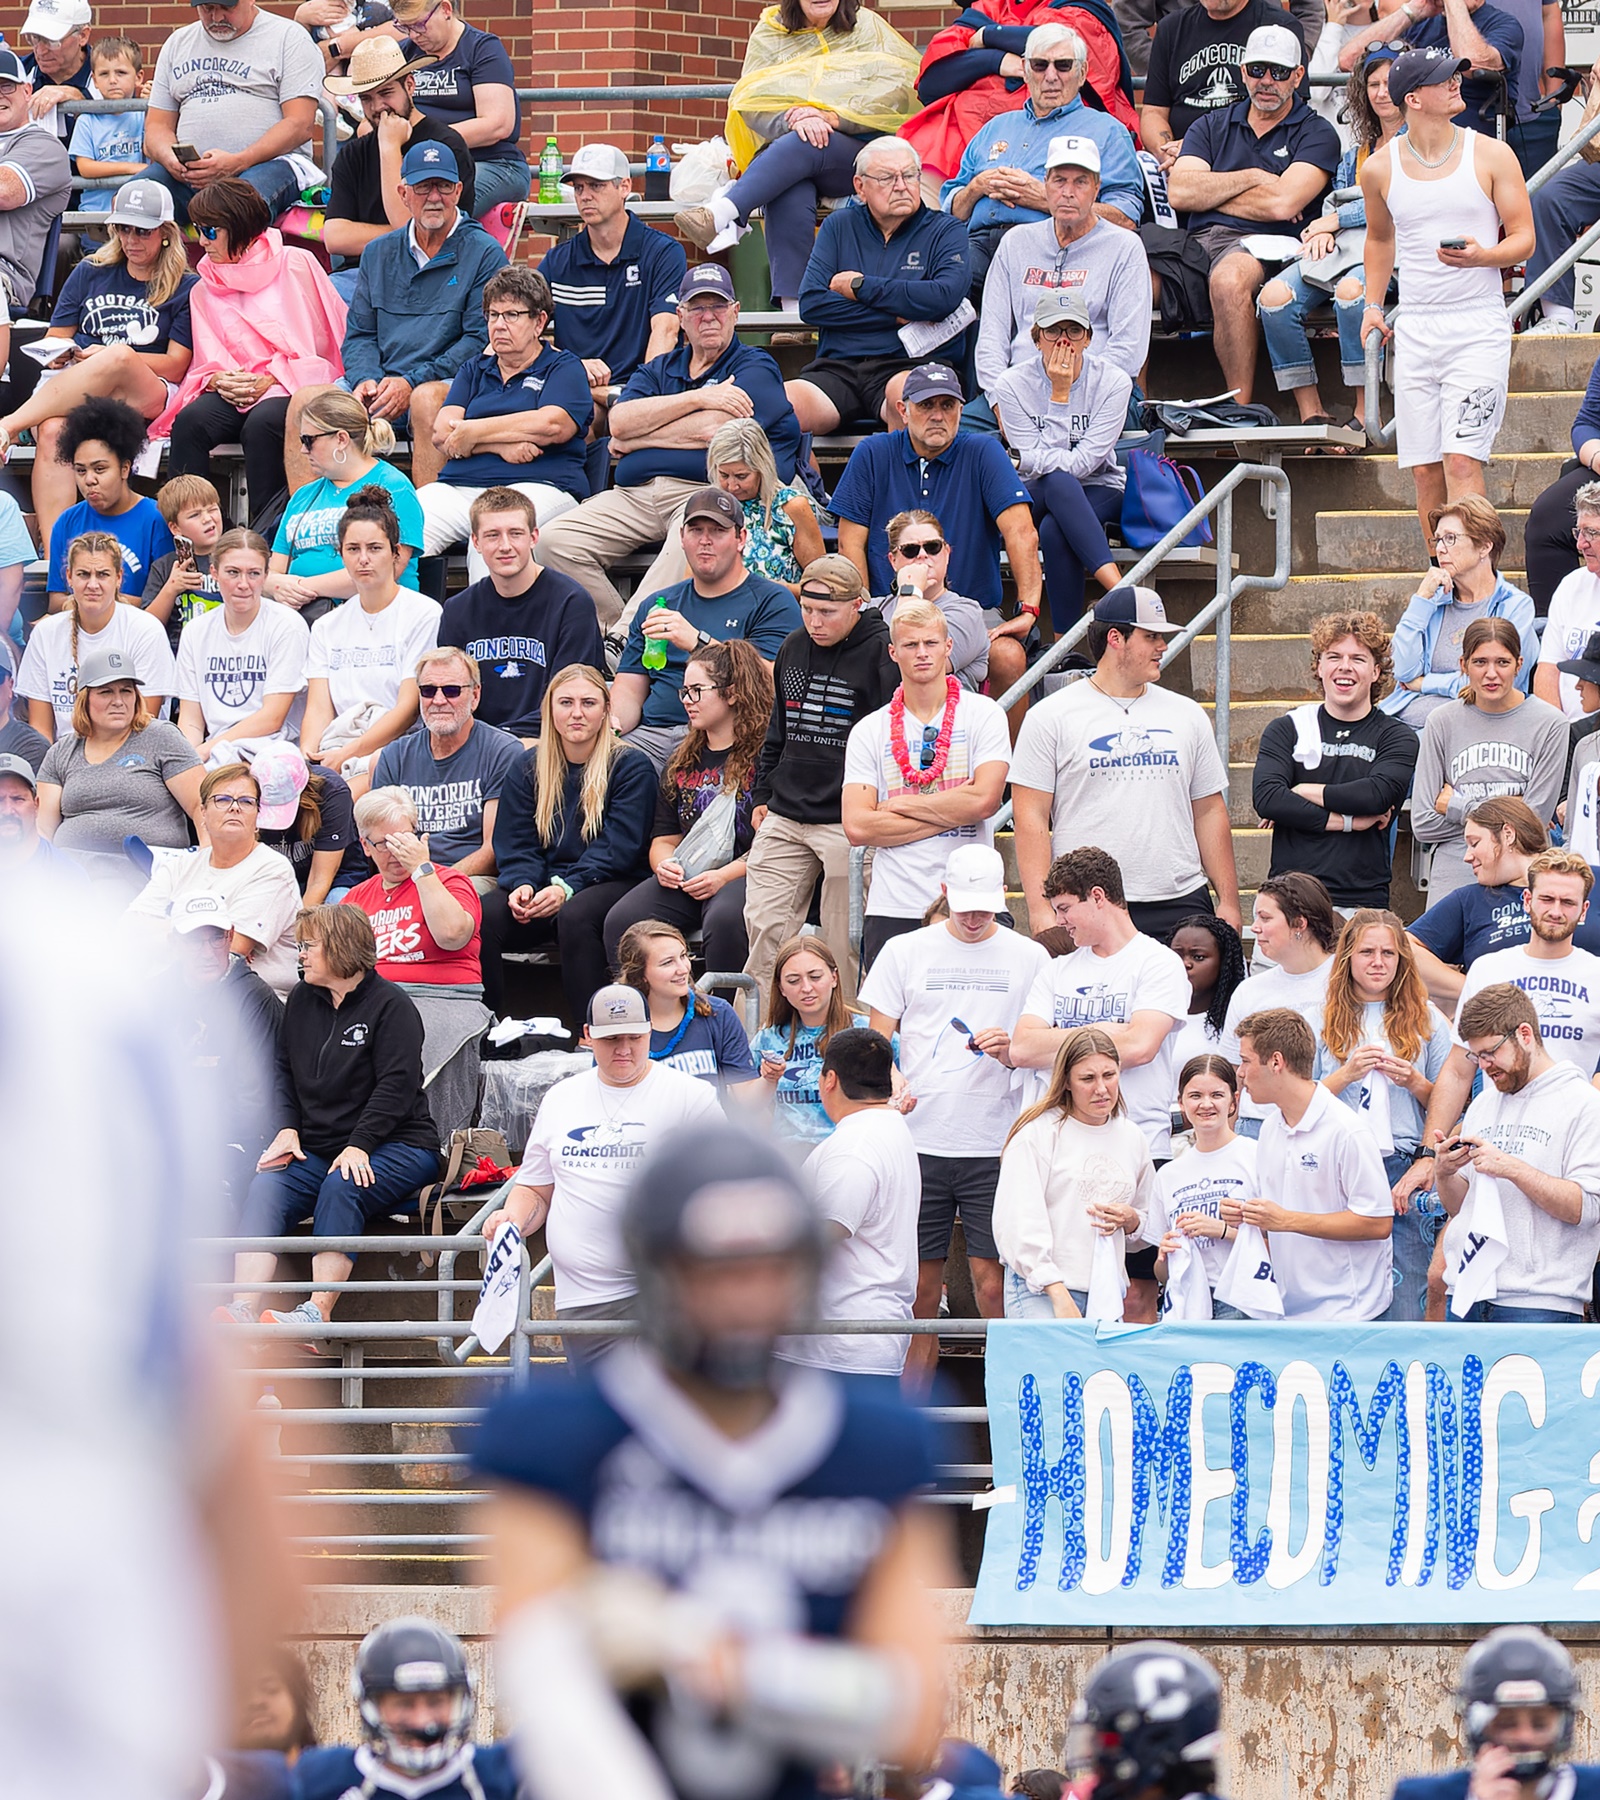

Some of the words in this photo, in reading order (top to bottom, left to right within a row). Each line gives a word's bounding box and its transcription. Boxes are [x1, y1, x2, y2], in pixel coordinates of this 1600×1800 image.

[172, 57, 252, 80] CONCORDIA
[1184, 96, 1211, 108] BULLDOG
[1066, 139, 1079, 150] C
[129, 190, 143, 205] C
[907, 252, 920, 266] C
[626, 265, 641, 282] C
[1059, 296, 1069, 307] C
[108, 653, 122, 669] C
[787, 733, 812, 742] STAND
[1089, 754, 1180, 770] CONCORDIA
[1090, 769, 1181, 777] UNIVERSITY
[1460, 782, 1487, 798] CROSS
[1487, 781, 1528, 796] COUNTRY
[415, 816, 468, 832] NEBRASKA
[191, 901, 214, 911] nerd
[374, 926, 385, 935] FOR
[386, 923, 398, 932] THE
[945, 984, 966, 992] TRACK
[971, 984, 990, 992] FIELD
[1054, 993, 1128, 1020] BULLDOG
[1541, 1023, 1584, 1041] DOGS
[562, 1146, 648, 1158] CONCORDIA
[562, 1160, 597, 1169] TRACK
[602, 1161, 609, 1169] &
[614, 1161, 637, 1170] FIEL
[1014, 1352, 1557, 1597] HOMECOMING
[1132, 1657, 1191, 1722] C
